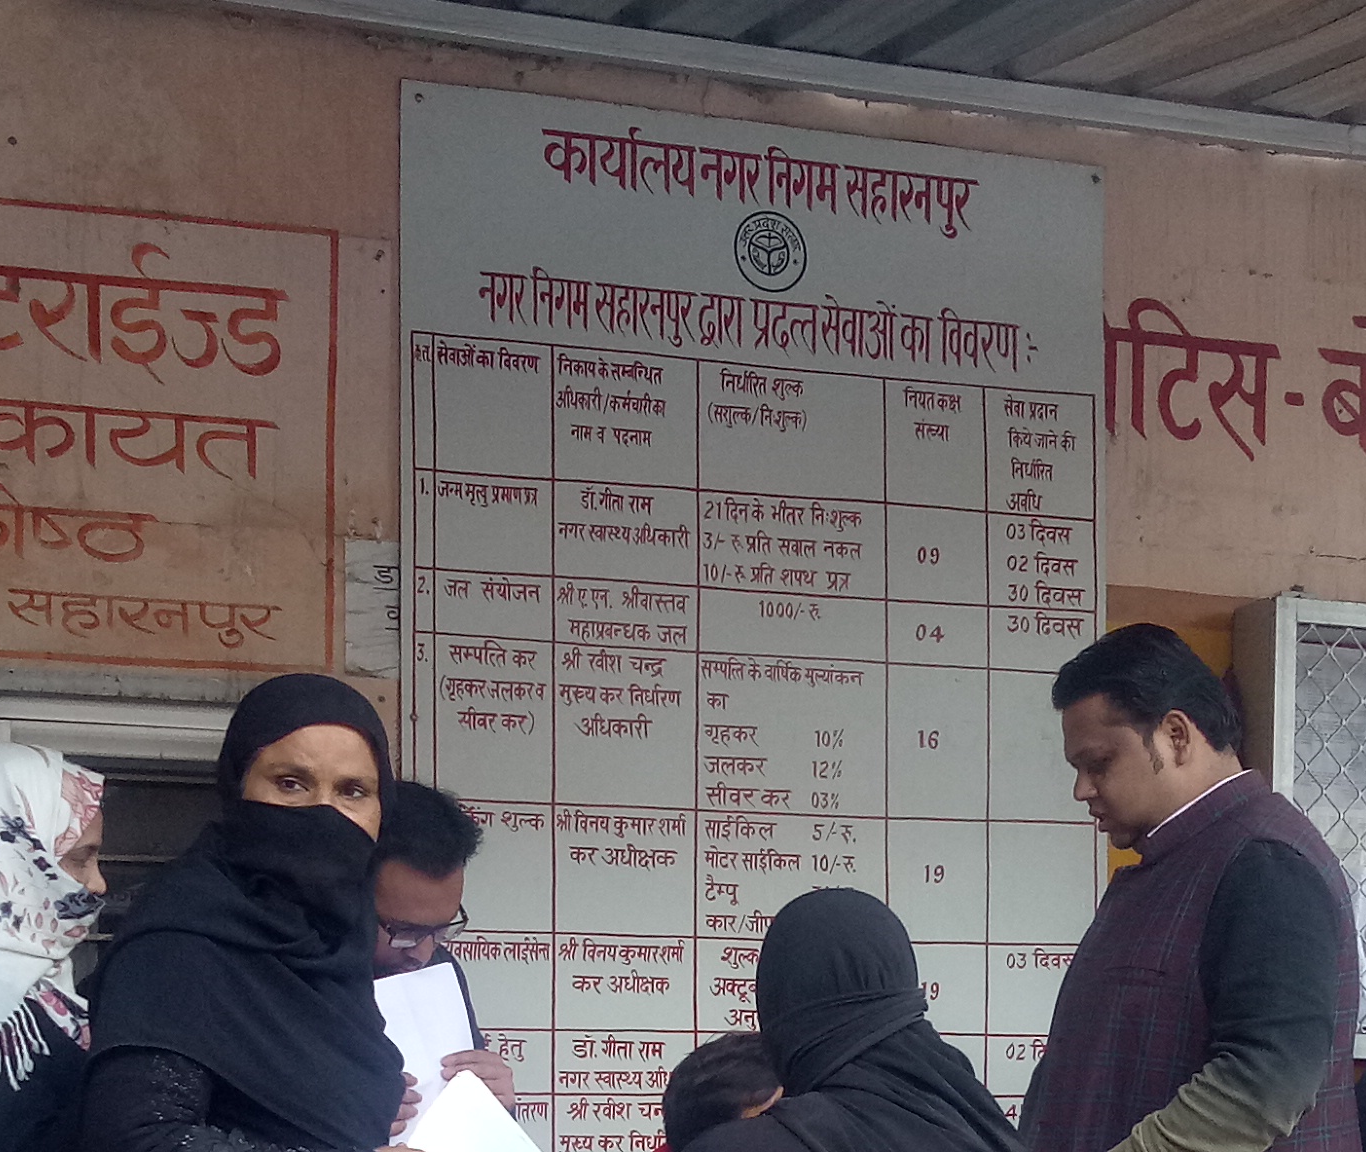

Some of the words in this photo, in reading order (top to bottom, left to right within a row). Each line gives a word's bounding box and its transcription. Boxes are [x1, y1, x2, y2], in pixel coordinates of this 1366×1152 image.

[542, 126, 696, 198] कार्यालय
[700, 147, 765, 208] नगर
[765, 145, 840, 214] निगम
[844, 164, 980, 239] सहारनपुर
[478, 270, 528, 326] नगर
[530, 265, 592, 331] निगम
[594, 279, 697, 349] सहारनपुर
[698, 291, 747, 348] द्वारा
[820, 293, 898, 363] सेवाओं
[899, 313, 937, 364] का
[936, 304, 1022, 374] विवरण
[437, 340, 476, 368] सेवाओं
[475, 350, 496, 371] का
[498, 346, 541, 374] विवरण
[557, 353, 596, 379] निकाय
[597, 357, 611, 380] के
[771, 376, 805, 401] शुल्क
[903, 386, 934, 410] नियत
[936, 393, 962, 414] कक्ष
[1004, 394, 1026, 418] सेवा
[1028, 399, 1059, 423] प्रदान
[570, 424, 593, 443] नाम
[597, 427, 606, 444] व
[611, 427, 653, 447] पदनाम
[1007, 426, 1033, 450] किये
[1033, 432, 1059, 452] जाने
[1059, 430, 1077, 454] की
[437, 480, 464, 501] जन्म
[491, 485, 523, 506] प्रमाण
[598, 488, 625, 514] गीता
[628, 494, 655, 516] राम
[703, 500, 723, 523] 21
[723, 497, 750, 525] दिन
[751, 497, 766, 521] के
[771, 500, 805, 527] भीतर
[557, 521, 587, 542] नगर
[631, 522, 692, 551] अधिकारी
[745, 531, 772, 554] प्रति
[823, 539, 863, 561] नकल
[1006, 521, 1027, 541] 03
[1029, 518, 1074, 547] दिवस
[917, 546, 942, 566] 09
[1006, 554, 1029, 574] 02
[1033, 551, 1079, 579] दिवस
[749, 562, 775, 587] प्रति
[780, 568, 817, 590] शपथ
[444, 578, 472, 600] जल
[480, 577, 542, 604] संयोजन
[557, 579, 574, 607] श्री
[622, 582, 691, 615] श्रीवास्तव
[1007, 583, 1031, 604] 30
[1035, 581, 1088, 608] दिवस
[7, 584, 282, 650] सहारनपुर
[1007, 615, 1031, 634] 30
[1035, 612, 1086, 641] दिवस
[657, 624, 688, 647] जल
[916, 624, 945, 643] 04
[511, 650, 538, 670] कर
[561, 646, 582, 671] श्री
[587, 648, 623, 674] रवीश
[629, 656, 667, 678] चन्द्र
[747, 659, 763, 684] के
[763, 659, 803, 684] वार्षिक
[485, 679, 535, 701] जलकर
[558, 683, 597, 707] मुख्य
[600, 687, 624, 707] कर
[707, 693, 730, 711] का
[456, 707, 498, 735] सीवर
[574, 712, 653, 740] अधिकारी
[704, 723, 759, 750] गृहकर
[814, 728, 844, 750] 10%
[917, 729, 940, 749] 16
[704, 756, 768, 779] जलकर
[811, 759, 843, 781] 12%
[705, 785, 760, 810] सीवर
[761, 789, 793, 811] कर
[811, 791, 839, 811] 03%
[500, 811, 545, 832] शुल्क
[556, 809, 572, 832] श्री
[574, 810, 612, 834] विनय
[613, 815, 657, 839] कुमार
[658, 812, 687, 837] शर्मा
[705, 815, 778, 841] साईकिल
[568, 845, 599, 866] कर
[601, 843, 679, 871] अधीक्षक
[704, 845, 739, 871] मोटर
[923, 863, 945, 883] 19
[558, 937, 578, 962] श्री
[582, 938, 618, 963] विनय
[618, 943, 659, 967] कुमार
[658, 939, 686, 964] शर्मा
[1006, 952, 1027, 970] 03
[572, 974, 604, 996] कर
[607, 969, 671, 996] अधीक्षक
[498, 1033, 527, 1062] हेतु
[602, 1034, 635, 1060] गीता
[637, 1041, 666, 1061] राम
[1006, 1043, 1026, 1061] 02
[558, 1070, 590, 1089] नगर
[566, 1097, 588, 1121] श्री
[592, 1097, 633, 1122] रवीश
